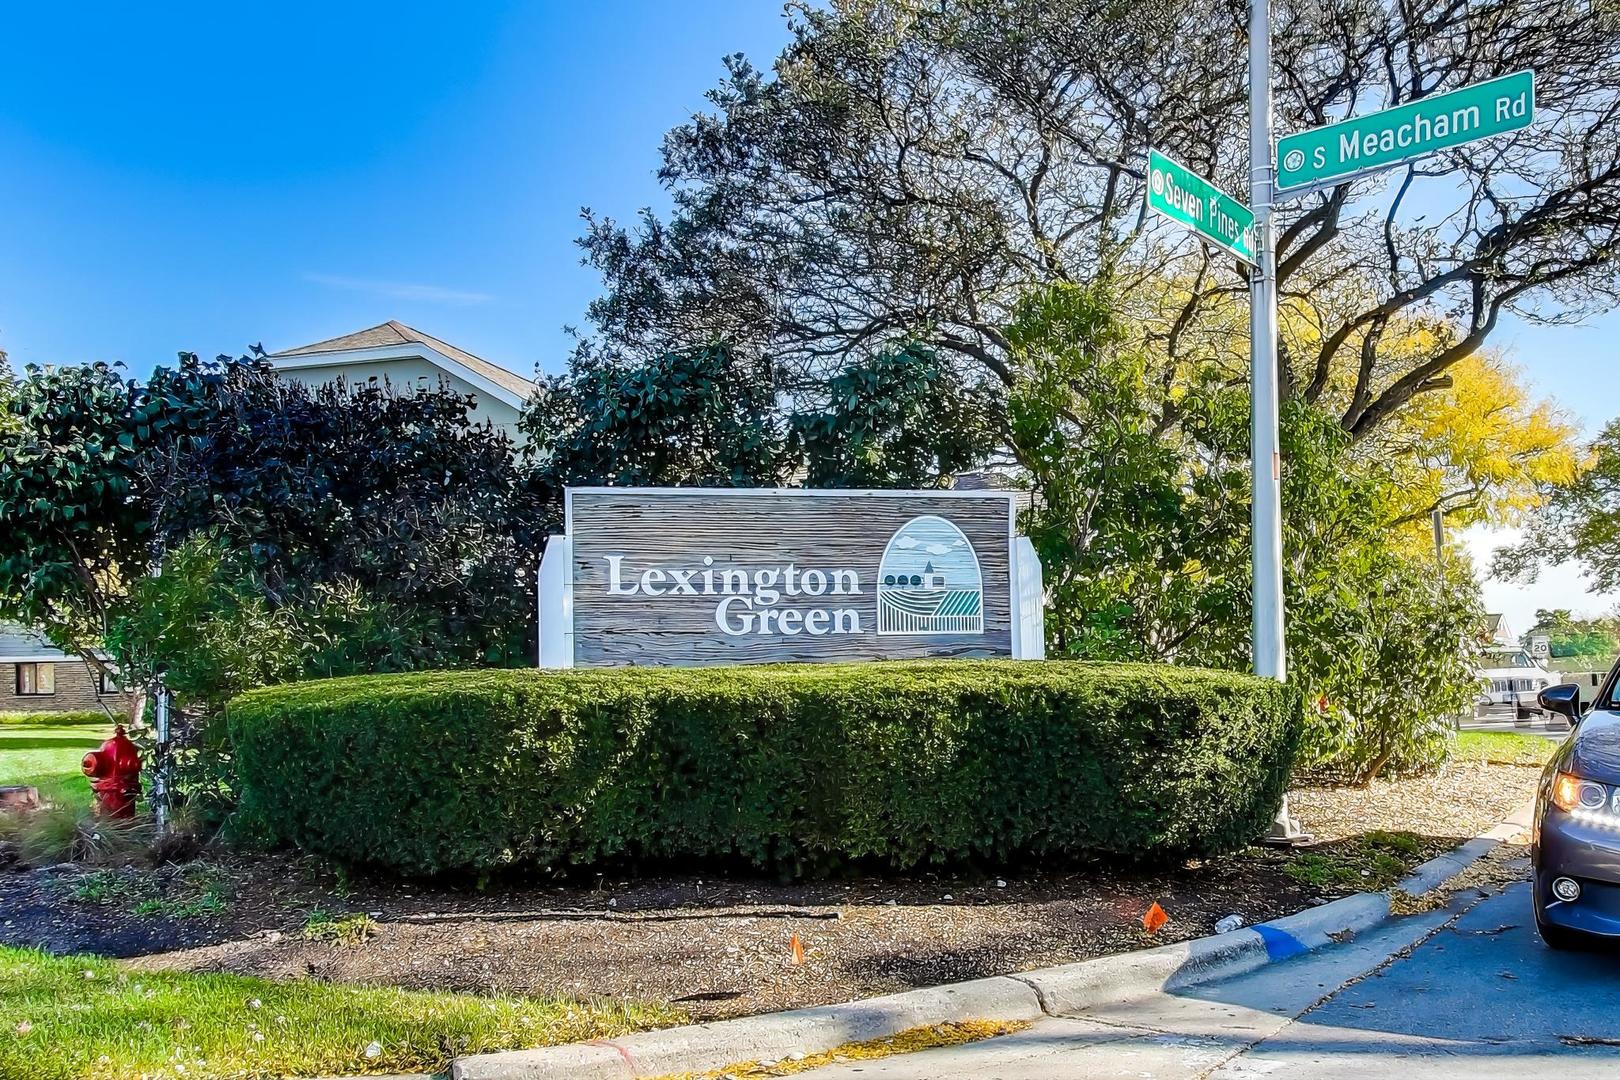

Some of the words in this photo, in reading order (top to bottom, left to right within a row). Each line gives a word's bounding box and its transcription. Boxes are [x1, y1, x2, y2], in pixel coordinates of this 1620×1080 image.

[1313, 146, 1326, 169] S
[1339, 106, 1480, 163] Meacham
[1495, 91, 1526, 122] Rd
[1164, 172, 1204, 222] Seven
[1209, 195, 1240, 240] Pines
[602, 555, 864, 606] Lexington
[715, 595, 865, 636] Green
[1534, 644, 1547, 652] 20
